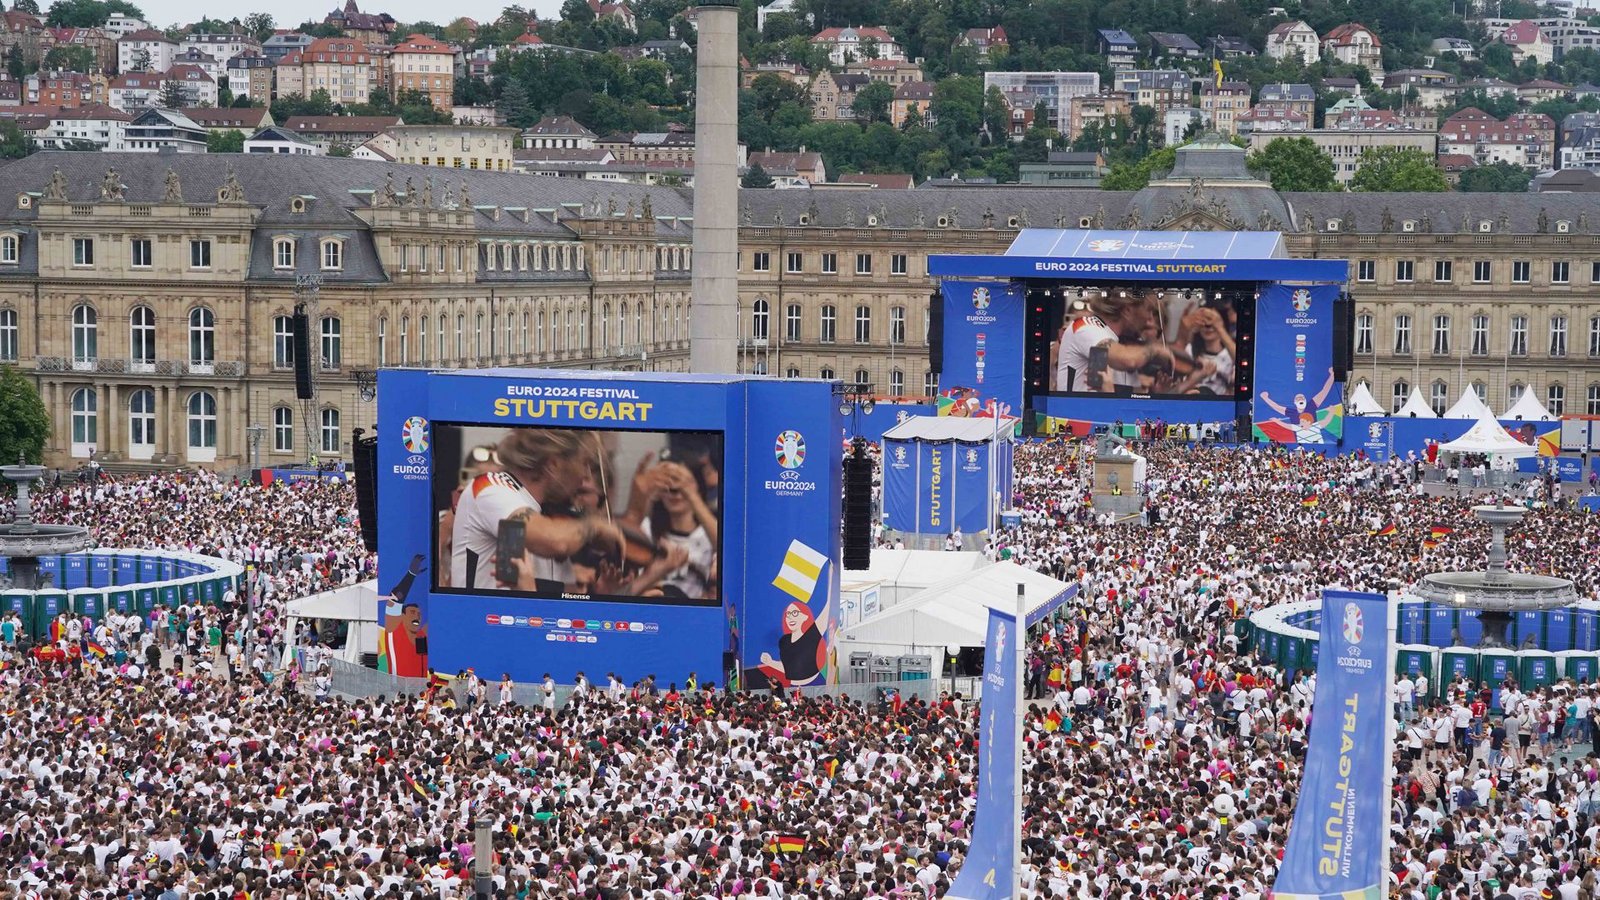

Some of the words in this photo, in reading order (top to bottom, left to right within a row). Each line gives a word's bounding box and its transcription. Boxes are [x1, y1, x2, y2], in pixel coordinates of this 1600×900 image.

[1035, 262, 1067, 271] EURO
[1069, 263, 1100, 272] 2024
[1101, 263, 1155, 273] FESTIVAL
[1156, 264, 1227, 273] STUTTGART
[507, 385, 542, 396] EURO
[544, 386, 578, 398] 2024
[580, 387, 639, 399] FESTIVAL
[493, 398, 653, 422] STUTTGART
[407, 455, 426, 465] UEFA
[780, 470, 800, 480] UEFA
[765, 481, 816, 490] EURO2024
[931, 448, 942, 527] STUTTGART
[561, 592, 590, 600] Hisense
[1195, 854, 1208, 867] 18
